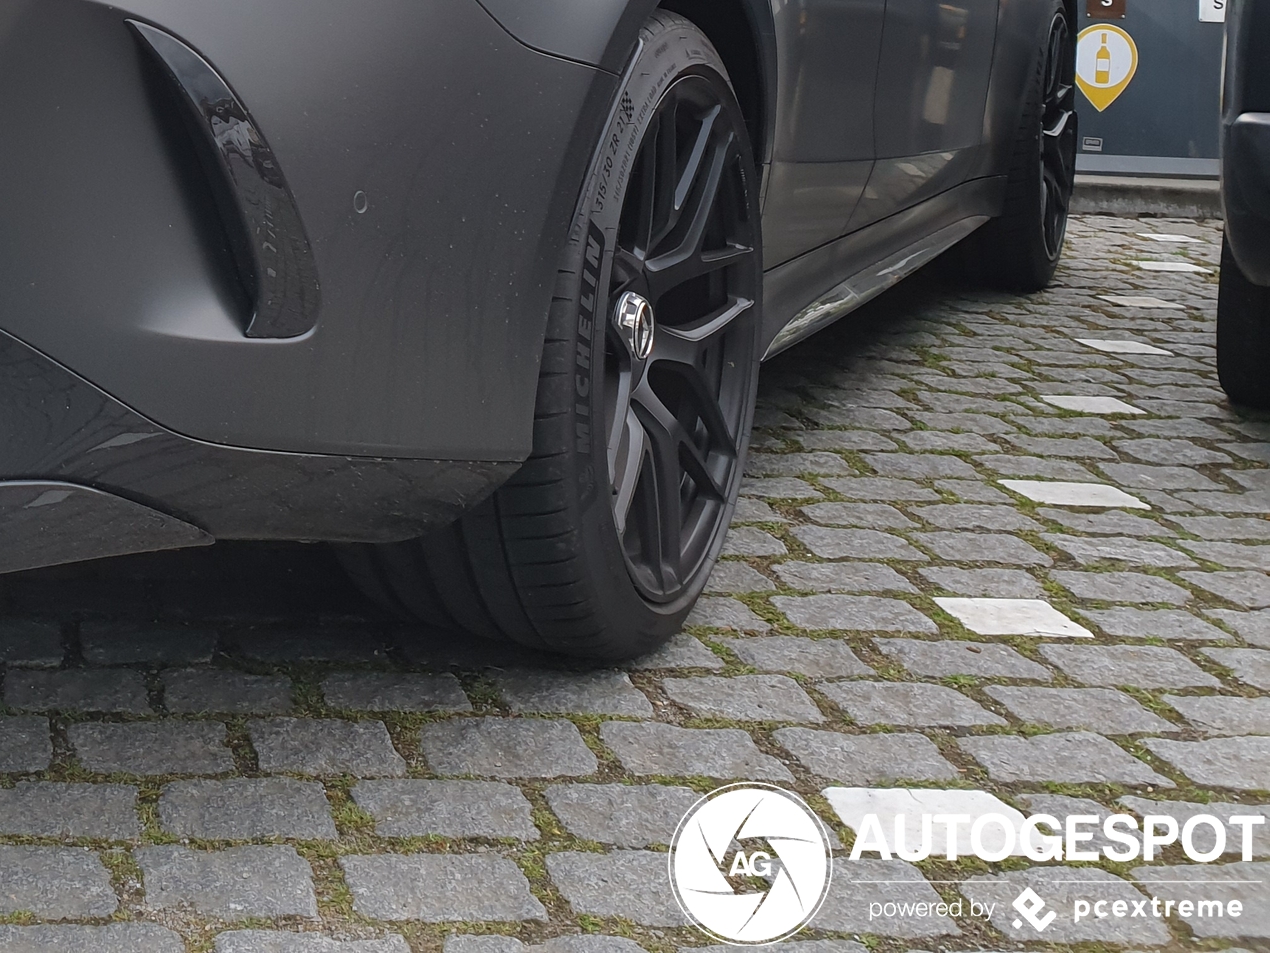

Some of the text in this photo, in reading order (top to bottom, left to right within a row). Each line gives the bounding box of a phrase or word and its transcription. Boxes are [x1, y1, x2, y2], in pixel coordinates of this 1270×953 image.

[637, 102, 649, 125] EXTRA
[595, 115, 626, 211] 315/30 ZR 21
[575, 233, 601, 454] MICHELIN
